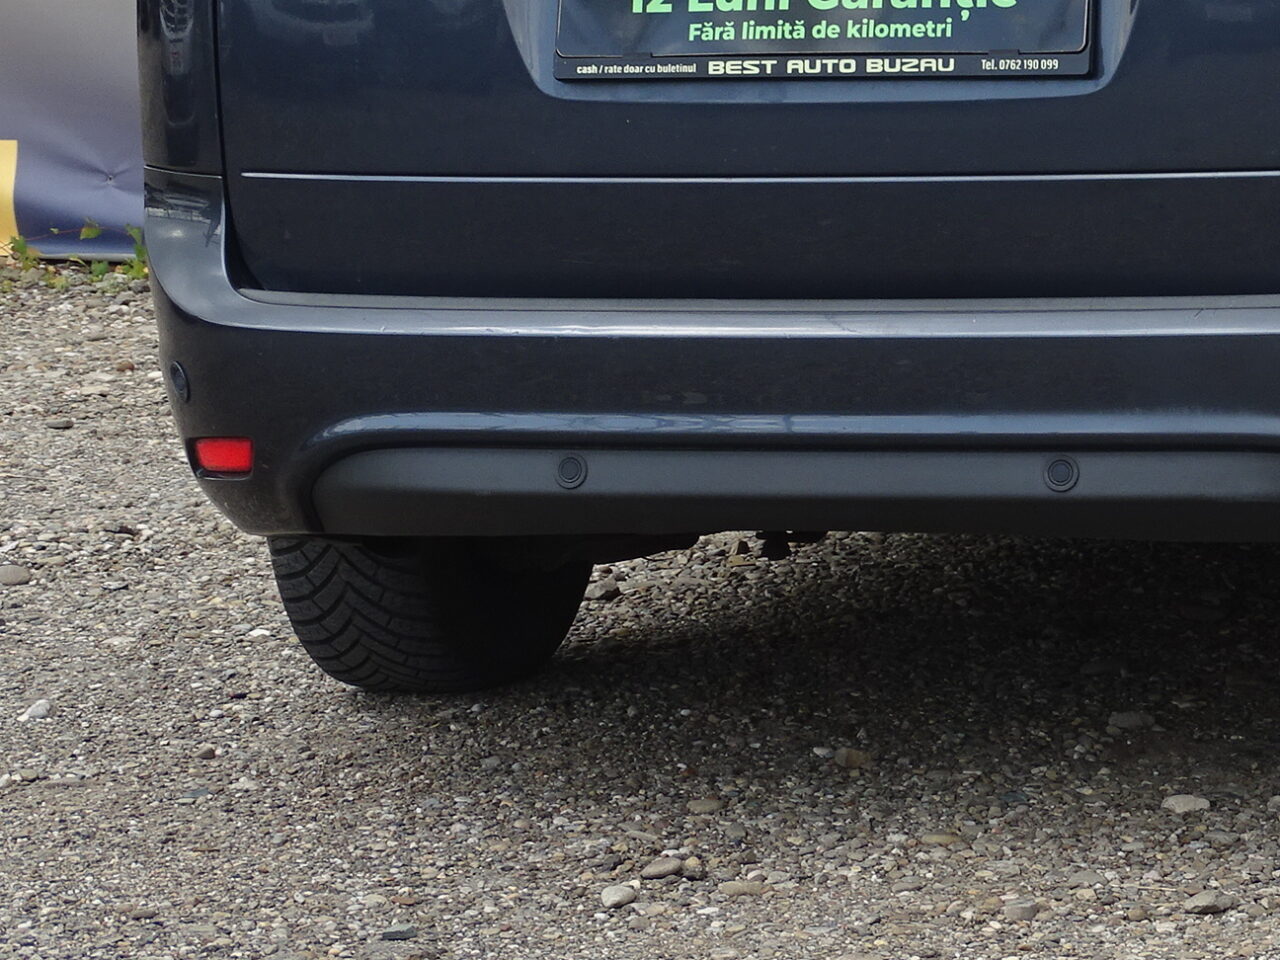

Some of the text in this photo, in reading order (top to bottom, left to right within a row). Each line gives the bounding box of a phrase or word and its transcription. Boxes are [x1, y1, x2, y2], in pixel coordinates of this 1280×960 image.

[688, 17, 953, 42] Fără limită de kilometri
[576, 64, 598, 74] cash
[604, 64, 623, 74] rate
[623, 63, 645, 74] doar
[645, 65, 656, 74] cu
[657, 63, 697, 73] buletinul
[708, 60, 778, 75] BEST
[786, 58, 857, 74] AUTO
[866, 58, 955, 73] BUZAU
[981, 59, 998, 70] Tel.
[999, 59, 1022, 70] 0762
[1022, 59, 1040, 70] 190
[1040, 58, 1059, 70] 099
